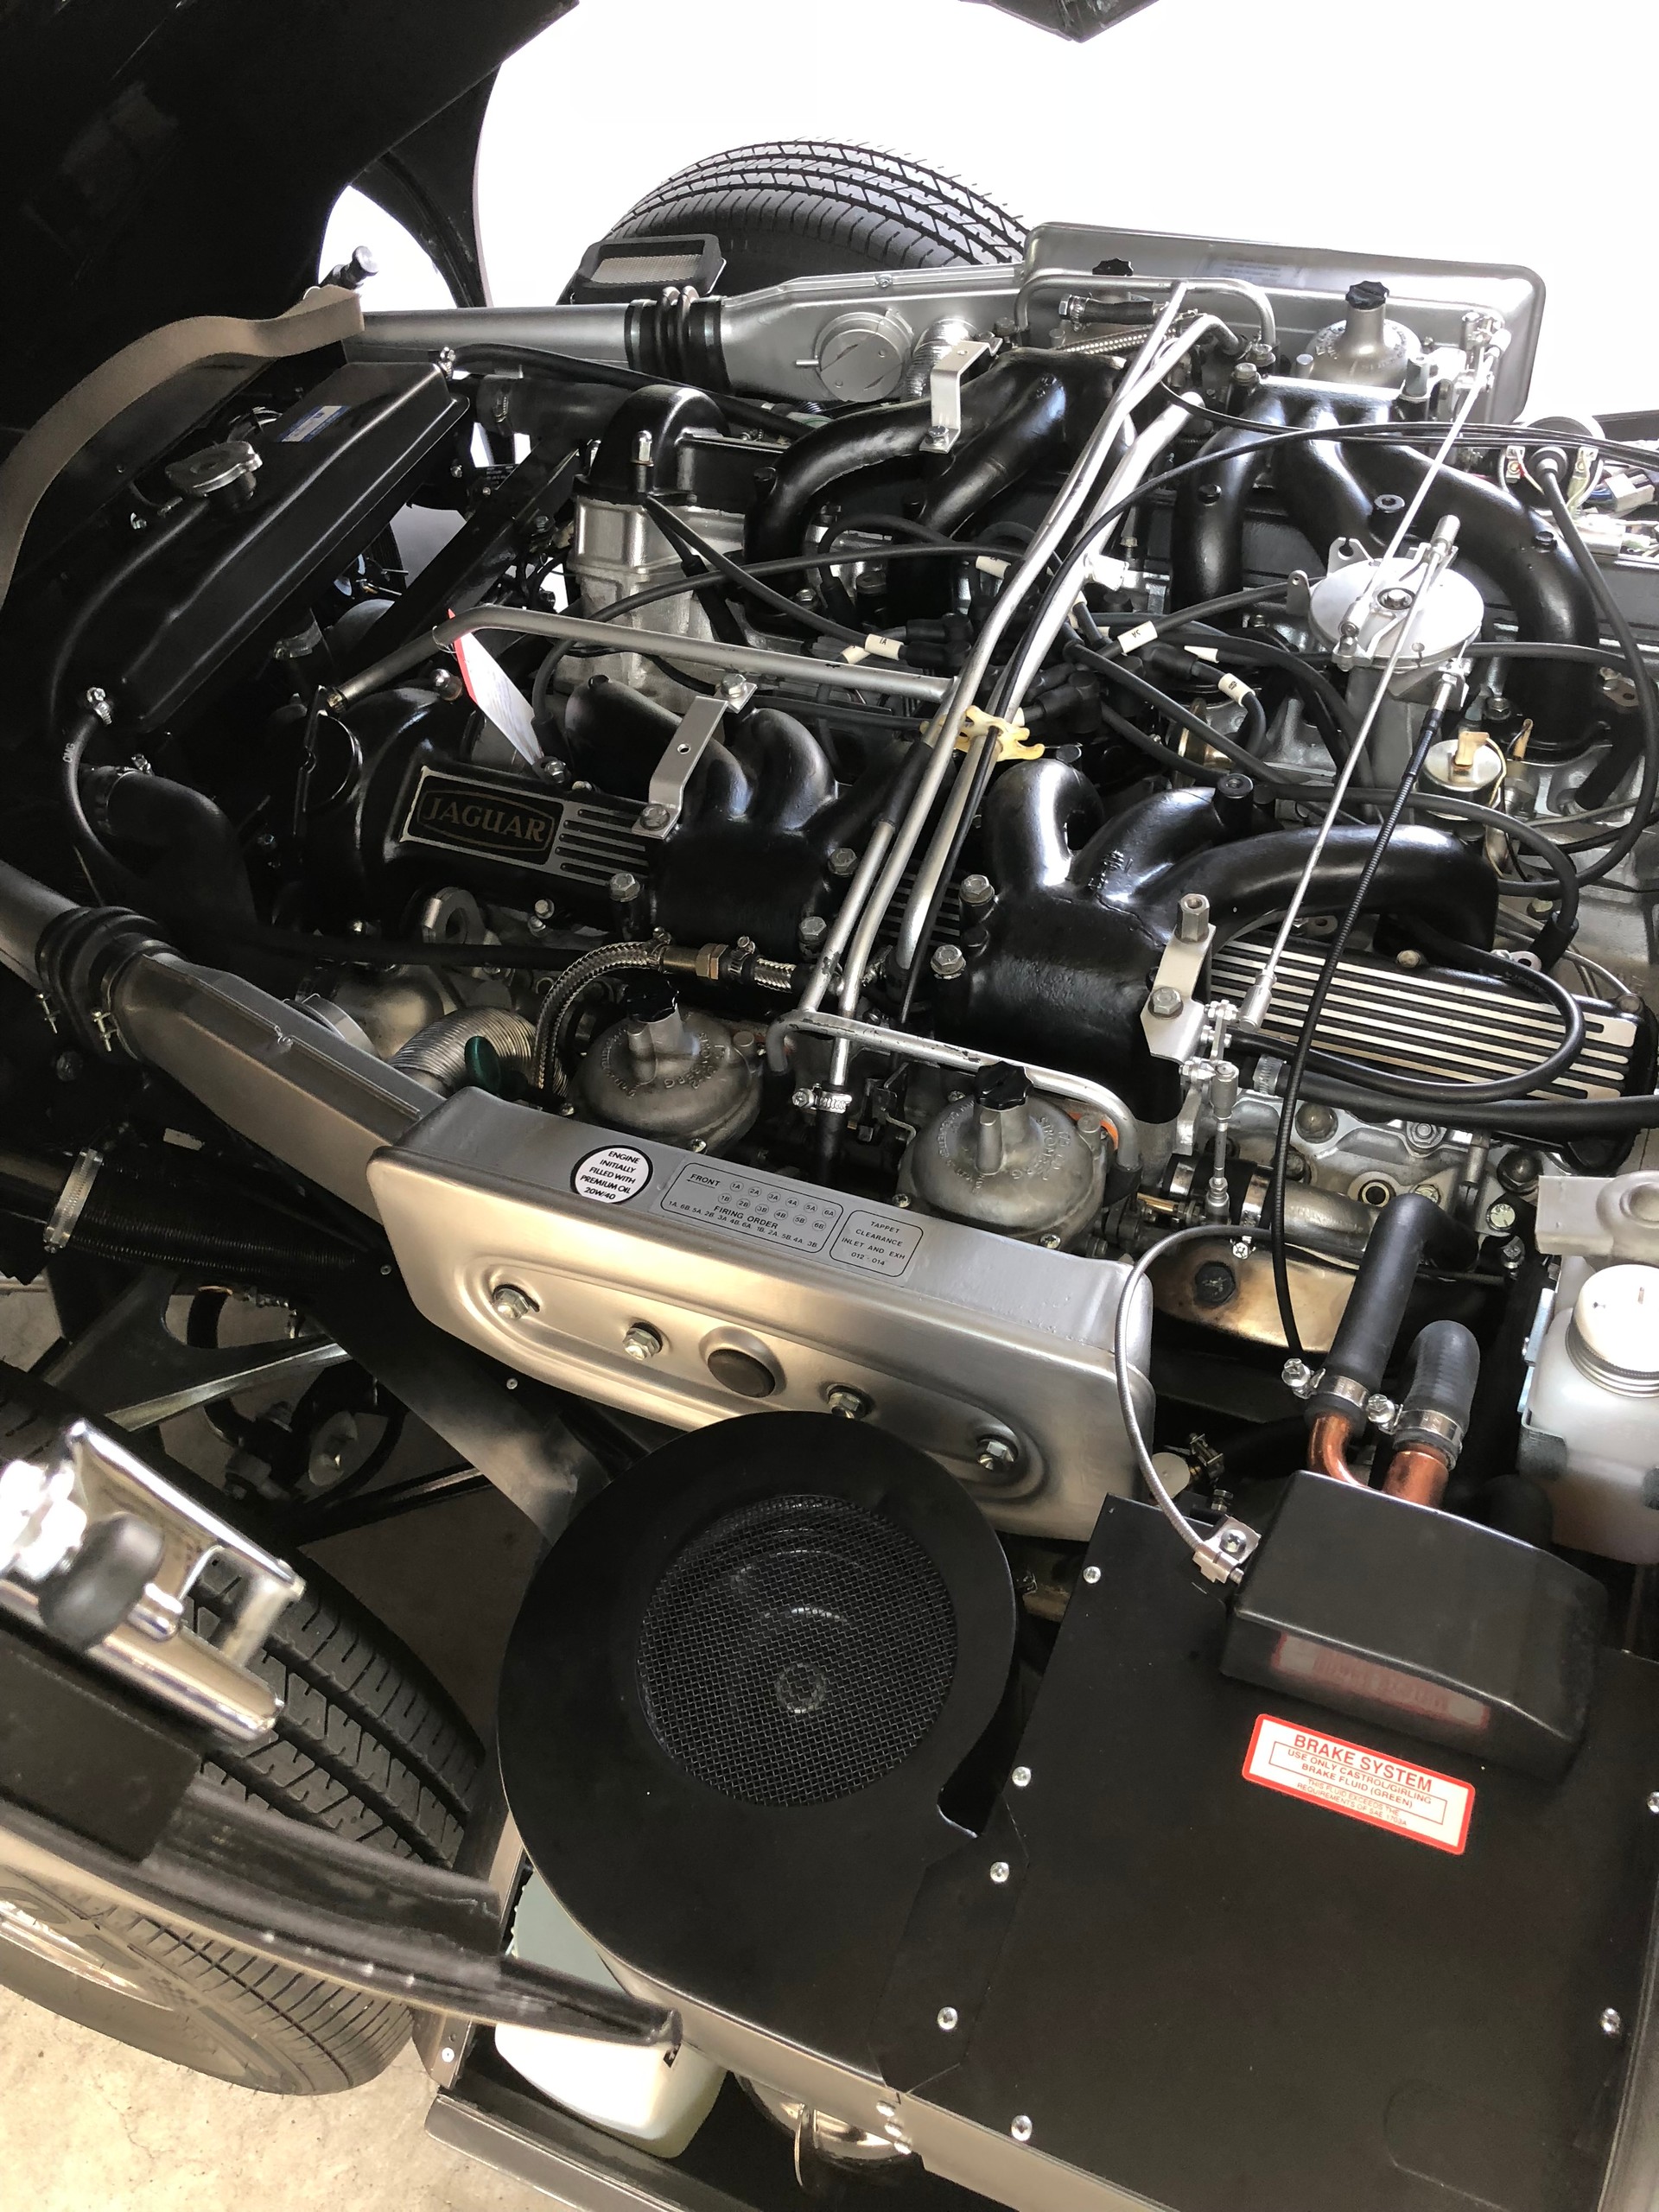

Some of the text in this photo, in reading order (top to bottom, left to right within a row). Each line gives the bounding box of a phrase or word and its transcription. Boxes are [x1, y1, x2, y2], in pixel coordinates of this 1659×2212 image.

[423, 797, 547, 843] JAGUAR
[600, 1159, 636, 1173] INITIALLY
[608, 1151, 640, 1164] ENGINE
[580, 1174, 631, 1194] PREMIUM OIL
[589, 1166, 636, 1185] FILLED WITH
[690, 1173, 721, 1186] FRONT
[584, 1186, 616, 1200] 20W/40
[714, 1205, 779, 1229] FIRING ORDER
[870, 1221, 900, 1234] TAPPET
[842, 1236, 906, 1260] INLET AND EXH
[855, 1229, 903, 1247] CLEARANCE
[1294, 1734, 1433, 1792] BRAKE SYSTEM
[1287, 1749, 1432, 1804] USE ONLY CASTROL/GIRLING
[1301, 1763, 1413, 1808] BRAKE FLUID (GREEN)
[1297, 1783, 1355, 1808] REQUIREMENTS
[1369, 1808, 1383, 1818] SAE
[1308, 1778, 1399, 1816] THIS FLUID EXCEEDS THE
